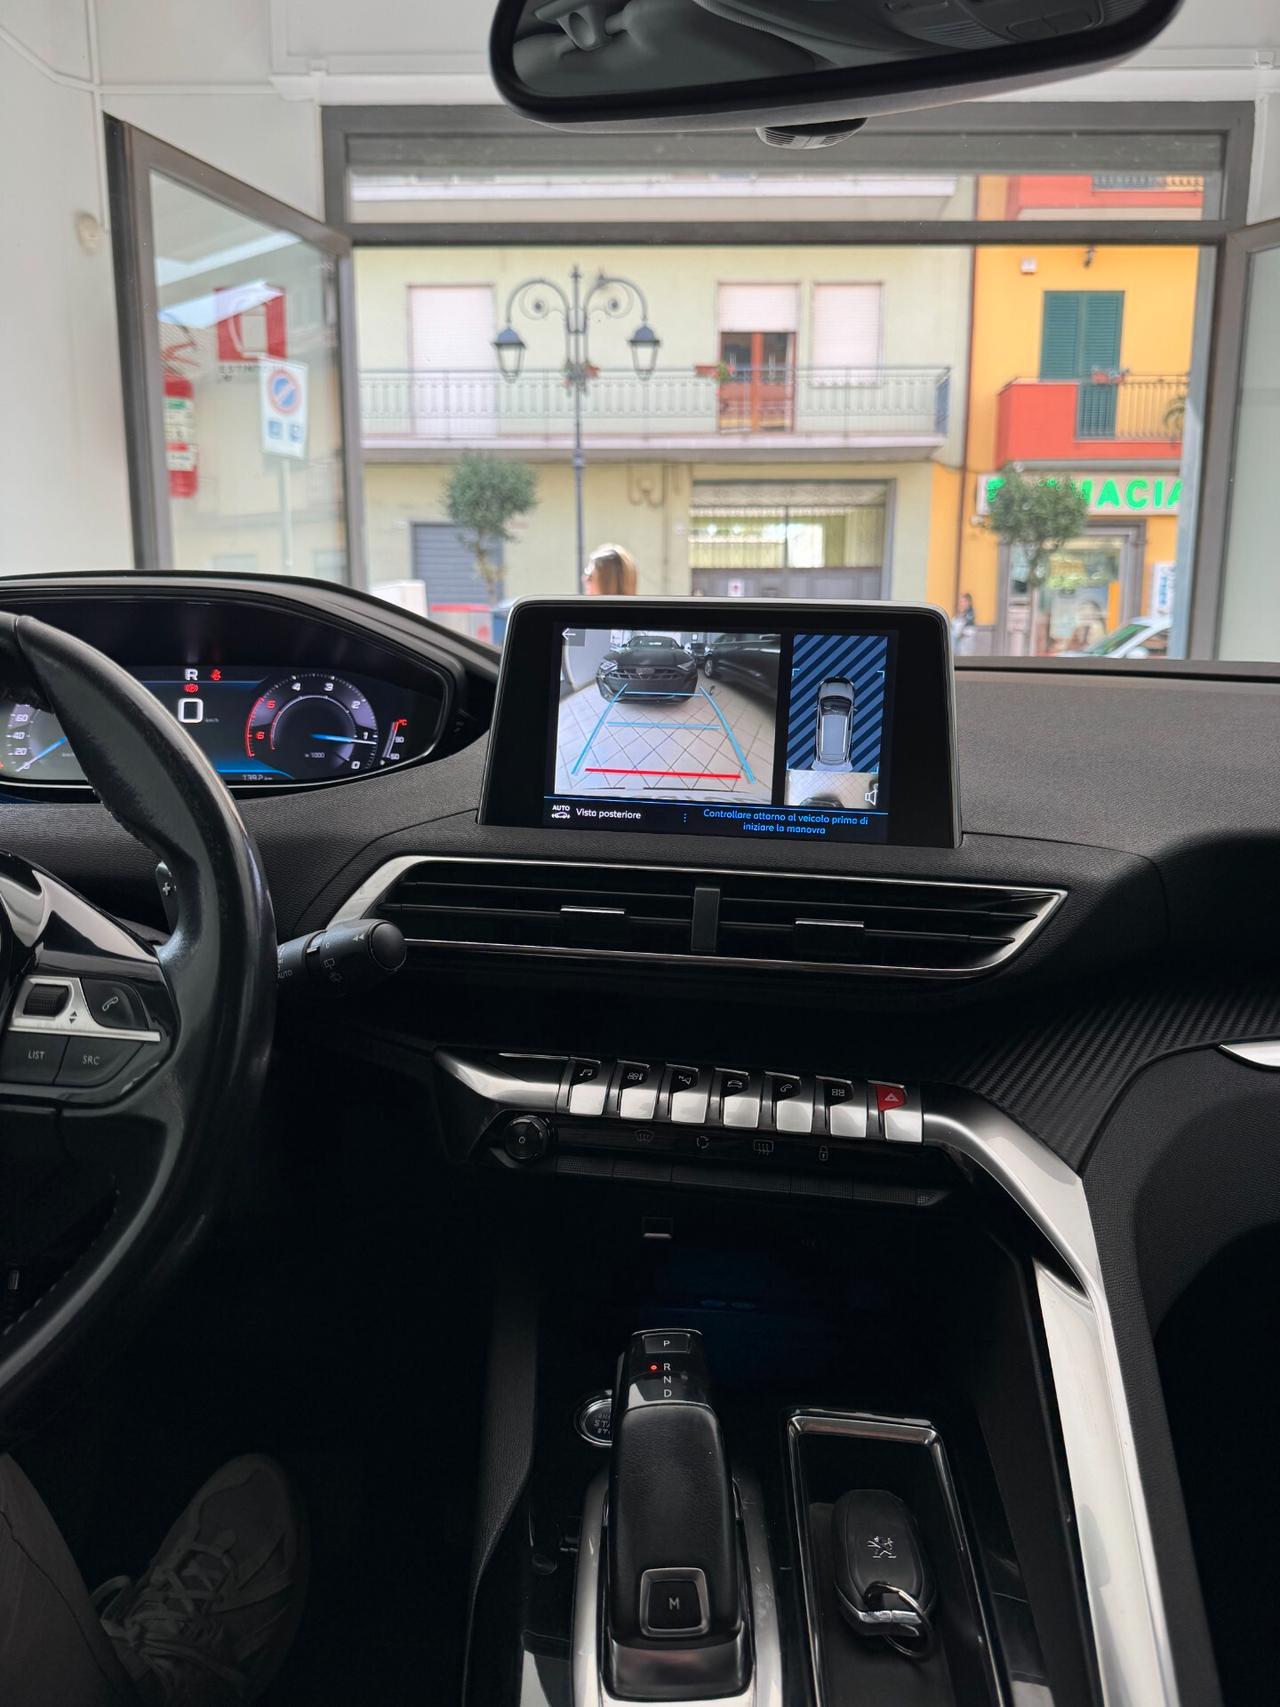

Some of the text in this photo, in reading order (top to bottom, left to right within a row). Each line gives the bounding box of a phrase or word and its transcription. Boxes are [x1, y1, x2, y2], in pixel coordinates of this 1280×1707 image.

[986, 478, 1184, 509] FACIA
[185, 668, 198, 680] R
[292, 683, 301, 691] 4
[324, 683, 334, 691] 3
[351, 701, 360, 709] 2
[178, 698, 204, 723] 0
[552, 804, 571, 812] AUTO
[598, 810, 642, 820] posteriore
[703, 808, 869, 826] Controllare attorno al veicolo prima di
[742, 821, 827, 835] iniziare la manovra
[28, 1050, 45, 1060] LIST
[82, 1055, 100, 1065] SRC
[663, 1363, 671, 1371] R
[663, 1376, 672, 1384] N
[663, 1389, 672, 1398] D
[669, 1597, 680, 1610] M
